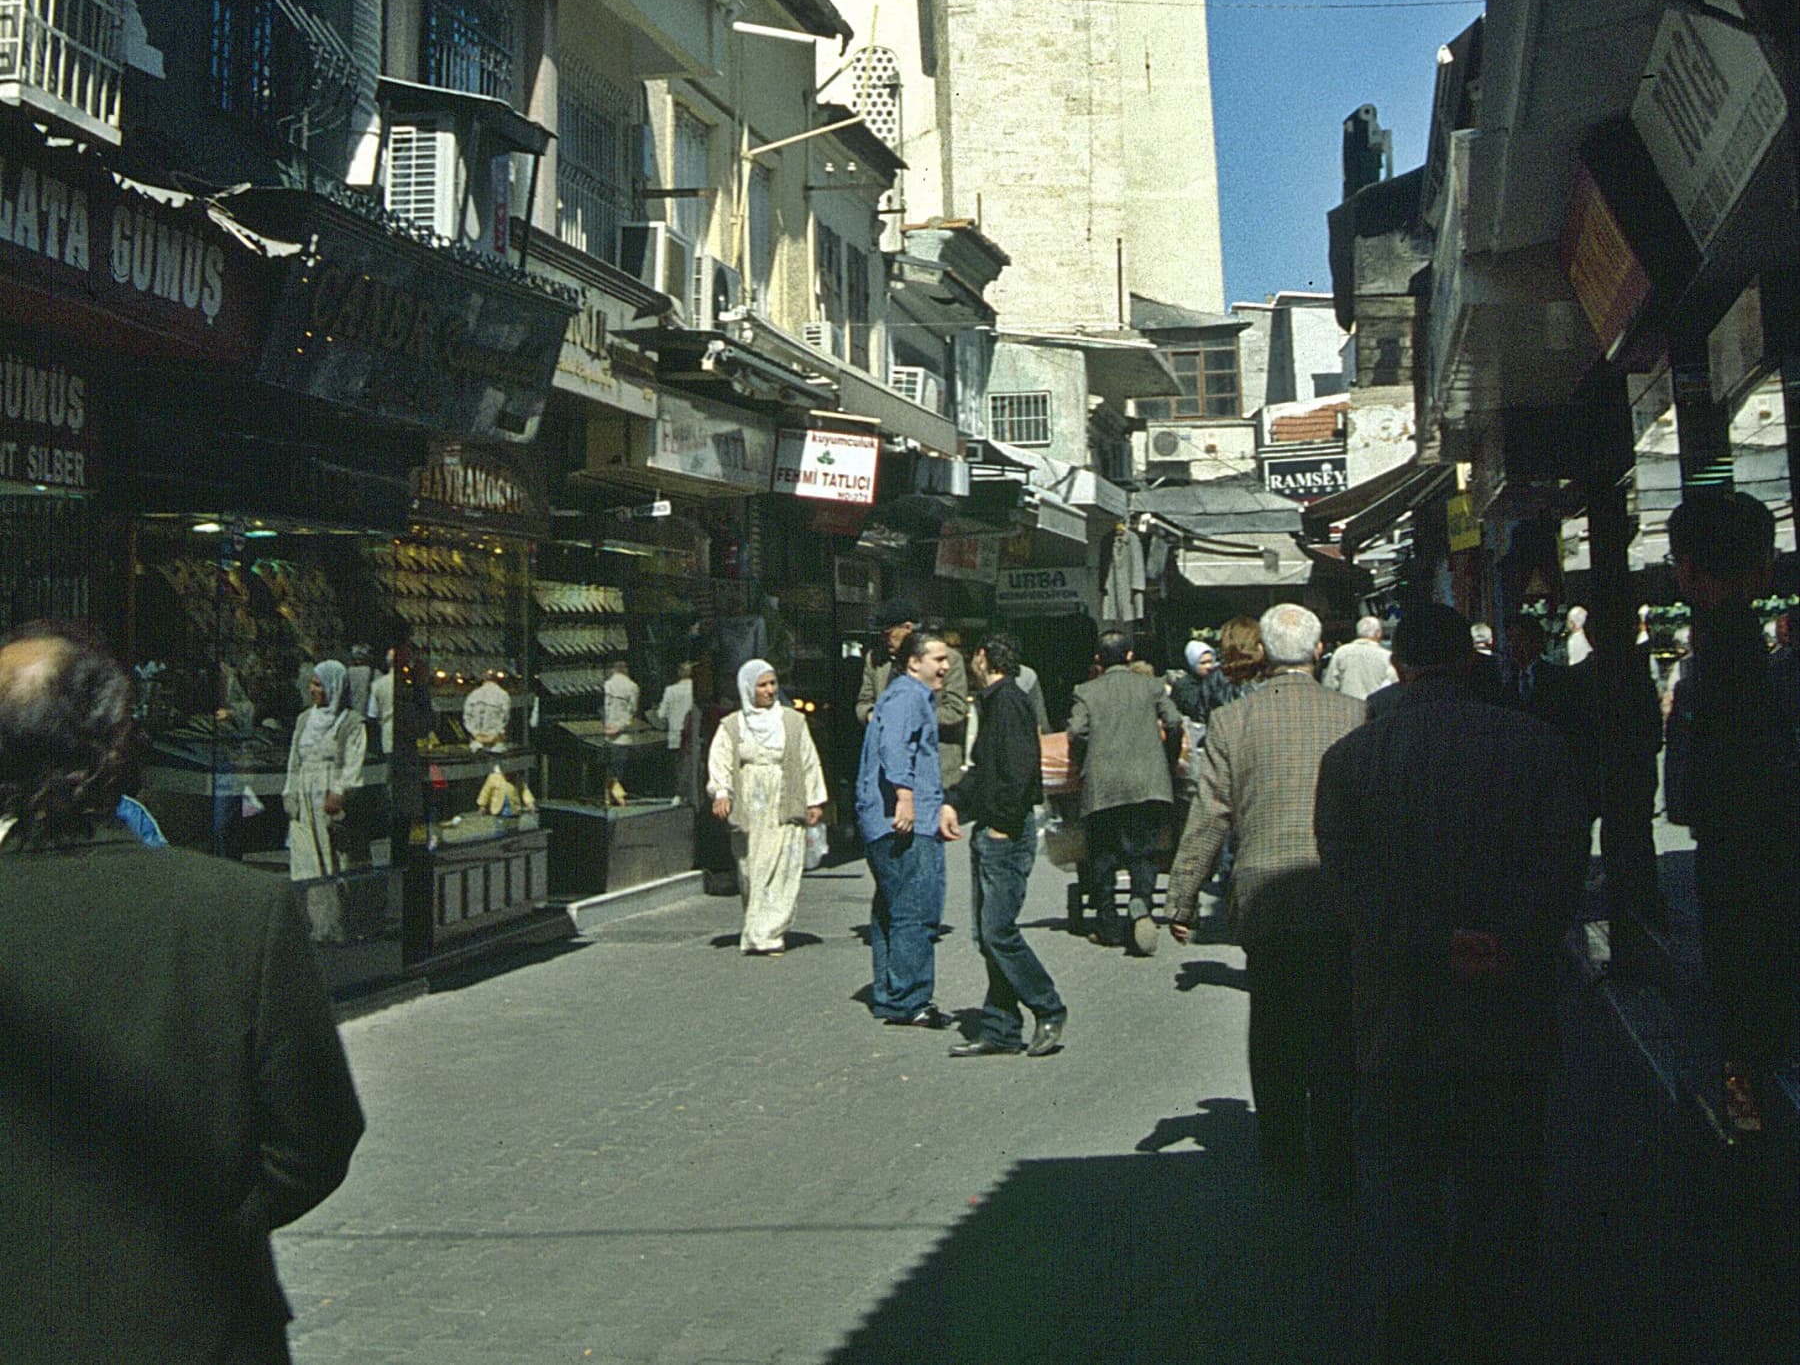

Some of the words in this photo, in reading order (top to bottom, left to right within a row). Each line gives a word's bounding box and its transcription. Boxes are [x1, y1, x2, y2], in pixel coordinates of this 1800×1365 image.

[111, 202, 226, 326] GÜMÜŞ
[0, 352, 86, 436] ÜMÜŞ
[811, 434, 876, 449] kuyumculuk
[822, 471, 872, 491] TATLICI
[1270, 470, 1346, 490] RAMSEY
[1008, 570, 1067, 589] URBA
